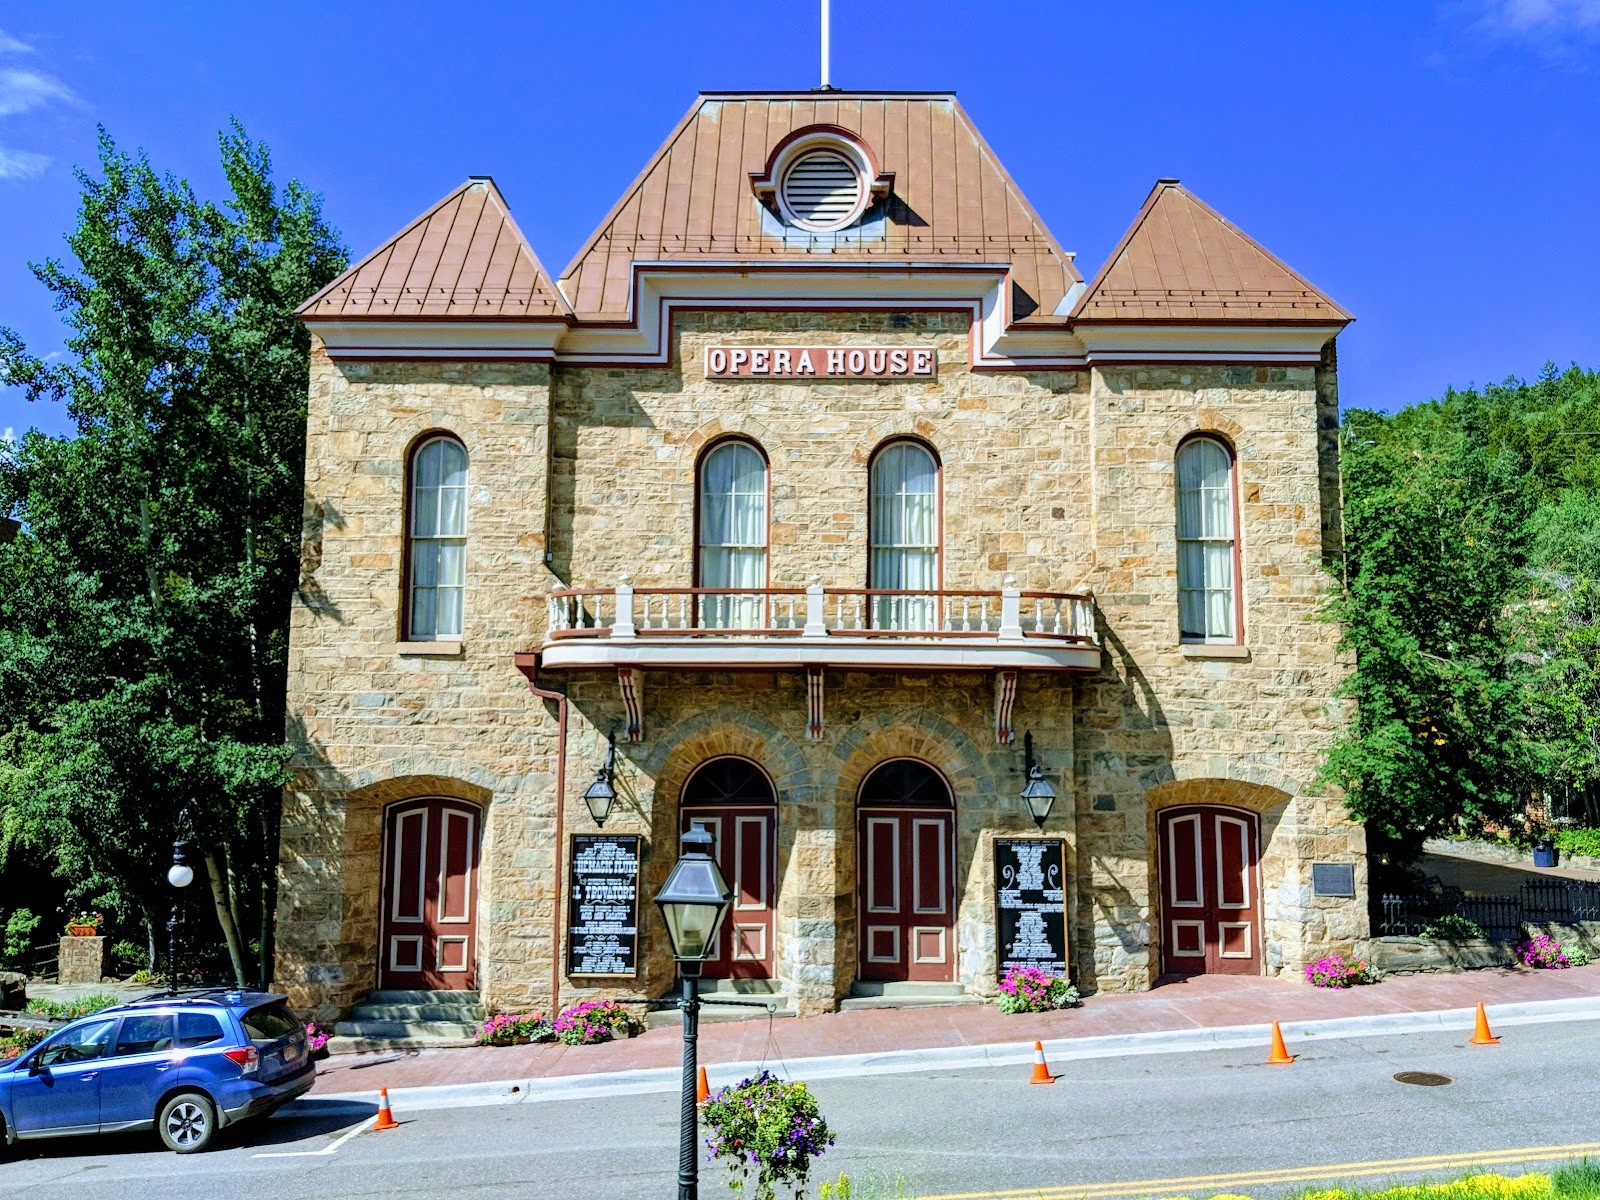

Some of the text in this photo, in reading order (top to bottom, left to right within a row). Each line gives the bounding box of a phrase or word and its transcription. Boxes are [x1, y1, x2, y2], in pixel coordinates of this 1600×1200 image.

[709, 350, 932, 374] OPERA HOUSE
[573, 860, 638, 873] THE MAGIC FLUTE
[572, 886, 635, 900] IL TROVATORE
